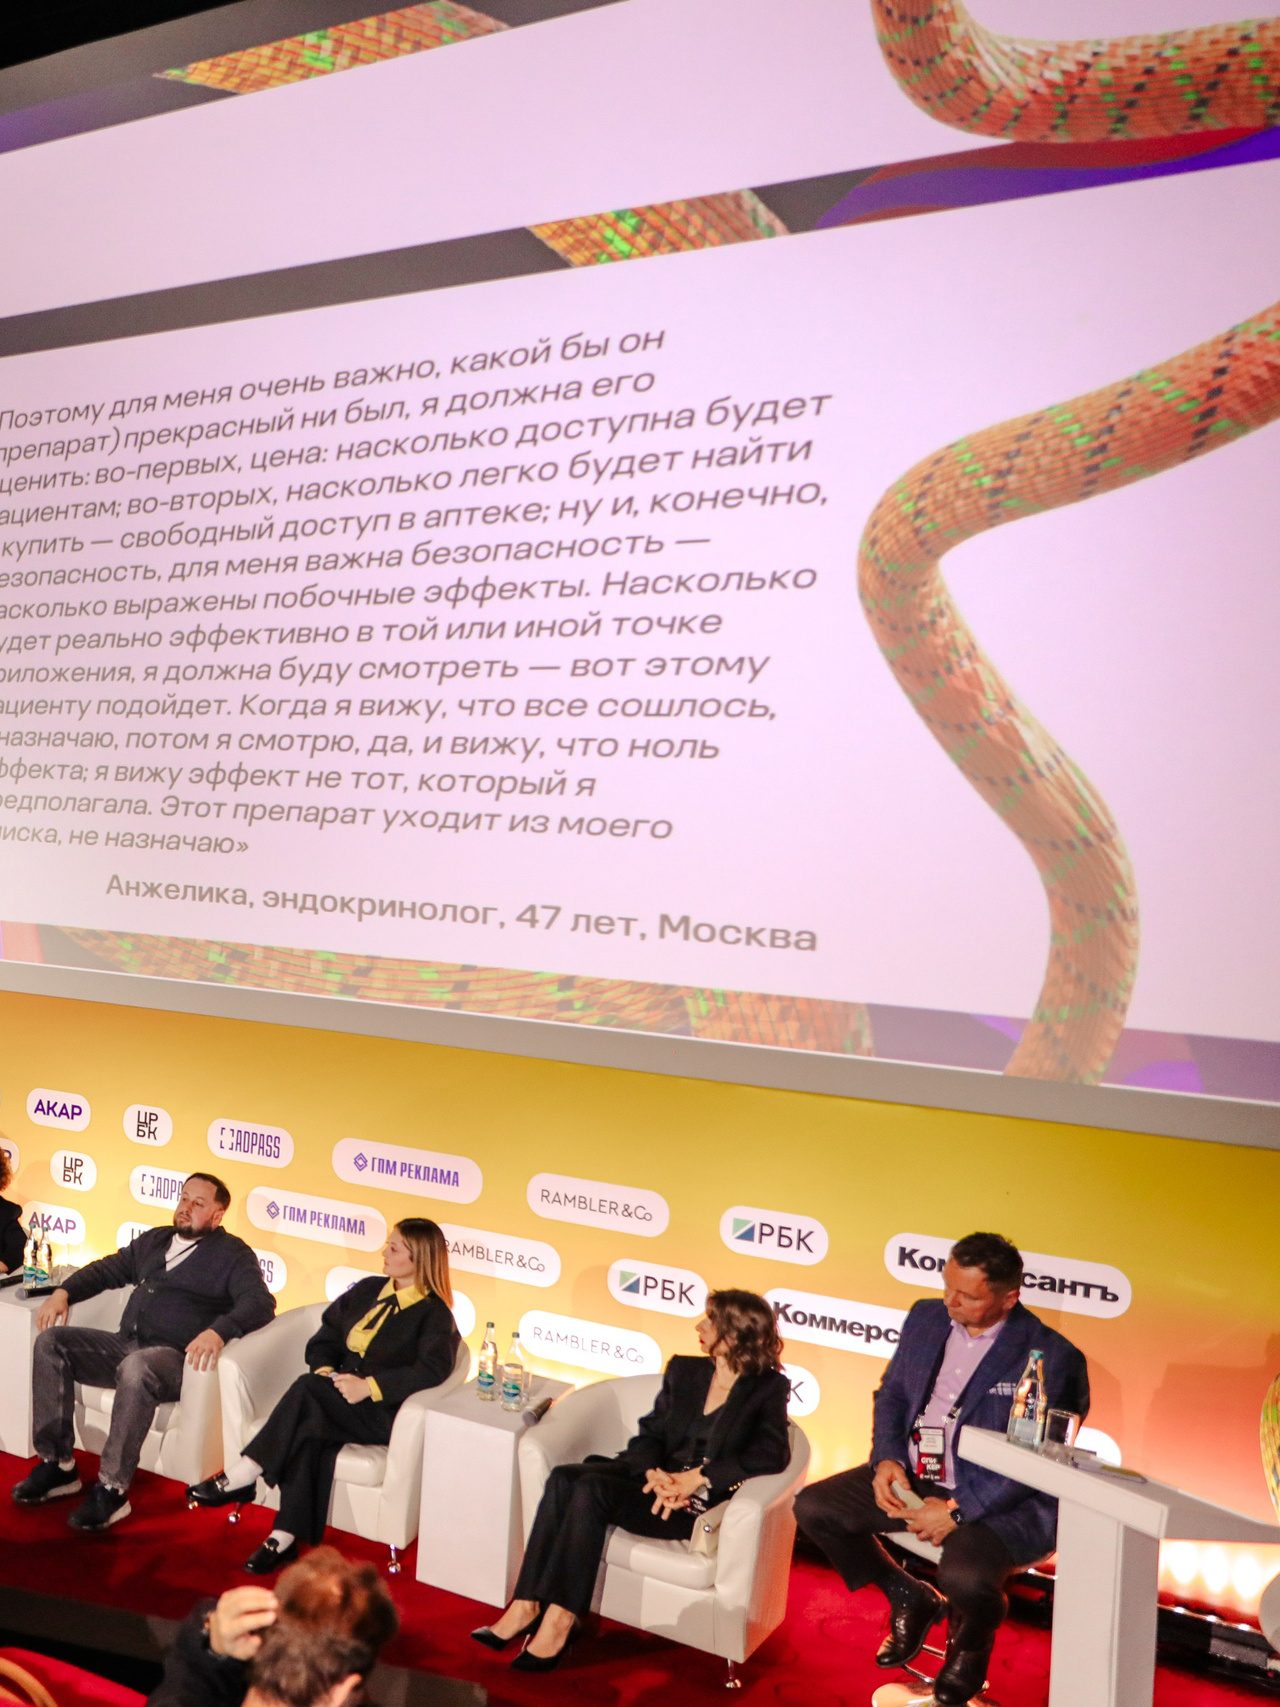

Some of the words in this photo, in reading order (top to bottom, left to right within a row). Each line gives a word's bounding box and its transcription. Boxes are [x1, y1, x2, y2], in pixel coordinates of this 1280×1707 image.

[108, 395, 157, 420] для
[163, 385, 233, 410] меня
[239, 375, 325, 400] очень
[333, 359, 441, 389] важно,
[450, 337, 552, 375] какой
[560, 332, 610, 361] бы
[618, 330, 665, 354] он
[124, 407, 295, 453] прекрасный
[300, 408, 337, 429] ни
[344, 397, 410, 424] был,
[444, 380, 583, 417] должна
[591, 372, 655, 397] его
[95, 454, 242, 484] во-первых,
[250, 446, 328, 472] цена:
[336, 427, 509, 461] насколько
[514, 408, 696, 449] доступна
[705, 394, 833, 432] будет
[127, 487, 277, 515] во-вторых,
[286, 470, 452, 502] насколько
[459, 461, 559, 488] легко
[568, 450, 684, 485] будет
[691, 436, 813, 469] найти
[2, 536, 84, 562] купить
[120, 515, 274, 549] свободный
[279, 513, 391, 542] доступ
[423, 502, 551, 529] аптеке;
[558, 498, 603, 526] ну
[611, 495, 639, 518] и,
[649, 482, 828, 514] конечно,
[168, 560, 219, 582] для
[225, 556, 299, 575] меня
[305, 549, 403, 572] важна
[411, 535, 665, 566] безопасность
[113, 594, 257, 620] выражены
[263, 583, 416, 609] побочные
[423, 575, 590, 610] эффекты.
[602, 568, 818, 596] Насколько
[55, 631, 162, 656] реально
[169, 623, 349, 653] эффективно
[382, 616, 439, 641] той
[445, 621, 507, 640] или
[514, 610, 602, 638] иной
[612, 614, 723, 636] точке
[162, 663, 272, 685] должна
[279, 656, 352, 687] буду
[359, 660, 519, 686] смотреть
[570, 657, 637, 677] вот
[644, 656, 771, 684] этому
[96, 693, 231, 719] подойдет.
[240, 694, 327, 719] Когда
[359, 699, 447, 724] вижу,
[458, 698, 516, 717] что
[524, 698, 588, 717] все
[597, 698, 776, 721] сошлось,
[126, 732, 209, 749] потом
[238, 733, 360, 759] смотрю,
[367, 735, 413, 757] да,
[450, 736, 545, 763] вижу,
[557, 737, 619, 757] что
[628, 738, 720, 759] ноль
[114, 766, 183, 790] вижу
[188, 761, 300, 792] эффект
[305, 771, 342, 788] не
[351, 771, 408, 793] тот,
[418, 769, 567, 802] который
[160, 795, 227, 818] Этот
[233, 803, 376, 830] препарат
[383, 809, 502, 833] уходит
[508, 814, 550, 833] из
[557, 816, 673, 839] моего
[69, 830, 98, 845] не
[105, 832, 249, 854] назначаю»
[106, 874, 254, 908] Анжелика,
[263, 891, 505, 929] эндокринолог,
[515, 904, 562, 930] 47
[570, 914, 646, 941] лет,
[659, 913, 817, 951] Москва
[33, 1099, 83, 1120] АКАР
[137, 1110, 159, 1128] ЦР
[136, 1123, 158, 1141] БК
[62, 1169, 83, 1186] БК
[63, 1155, 84, 1173] ЦР
[371, 1156, 397, 1176] ГПМ
[400, 1162, 460, 1188] РЕКЛАМА
[283, 1205, 307, 1224] ГПМ
[310, 1210, 366, 1236] РЕКЛАМА
[757, 1222, 815, 1254] РБК
[643, 1275, 695, 1306] РБК
[773, 1301, 900, 1344] Коммерс
